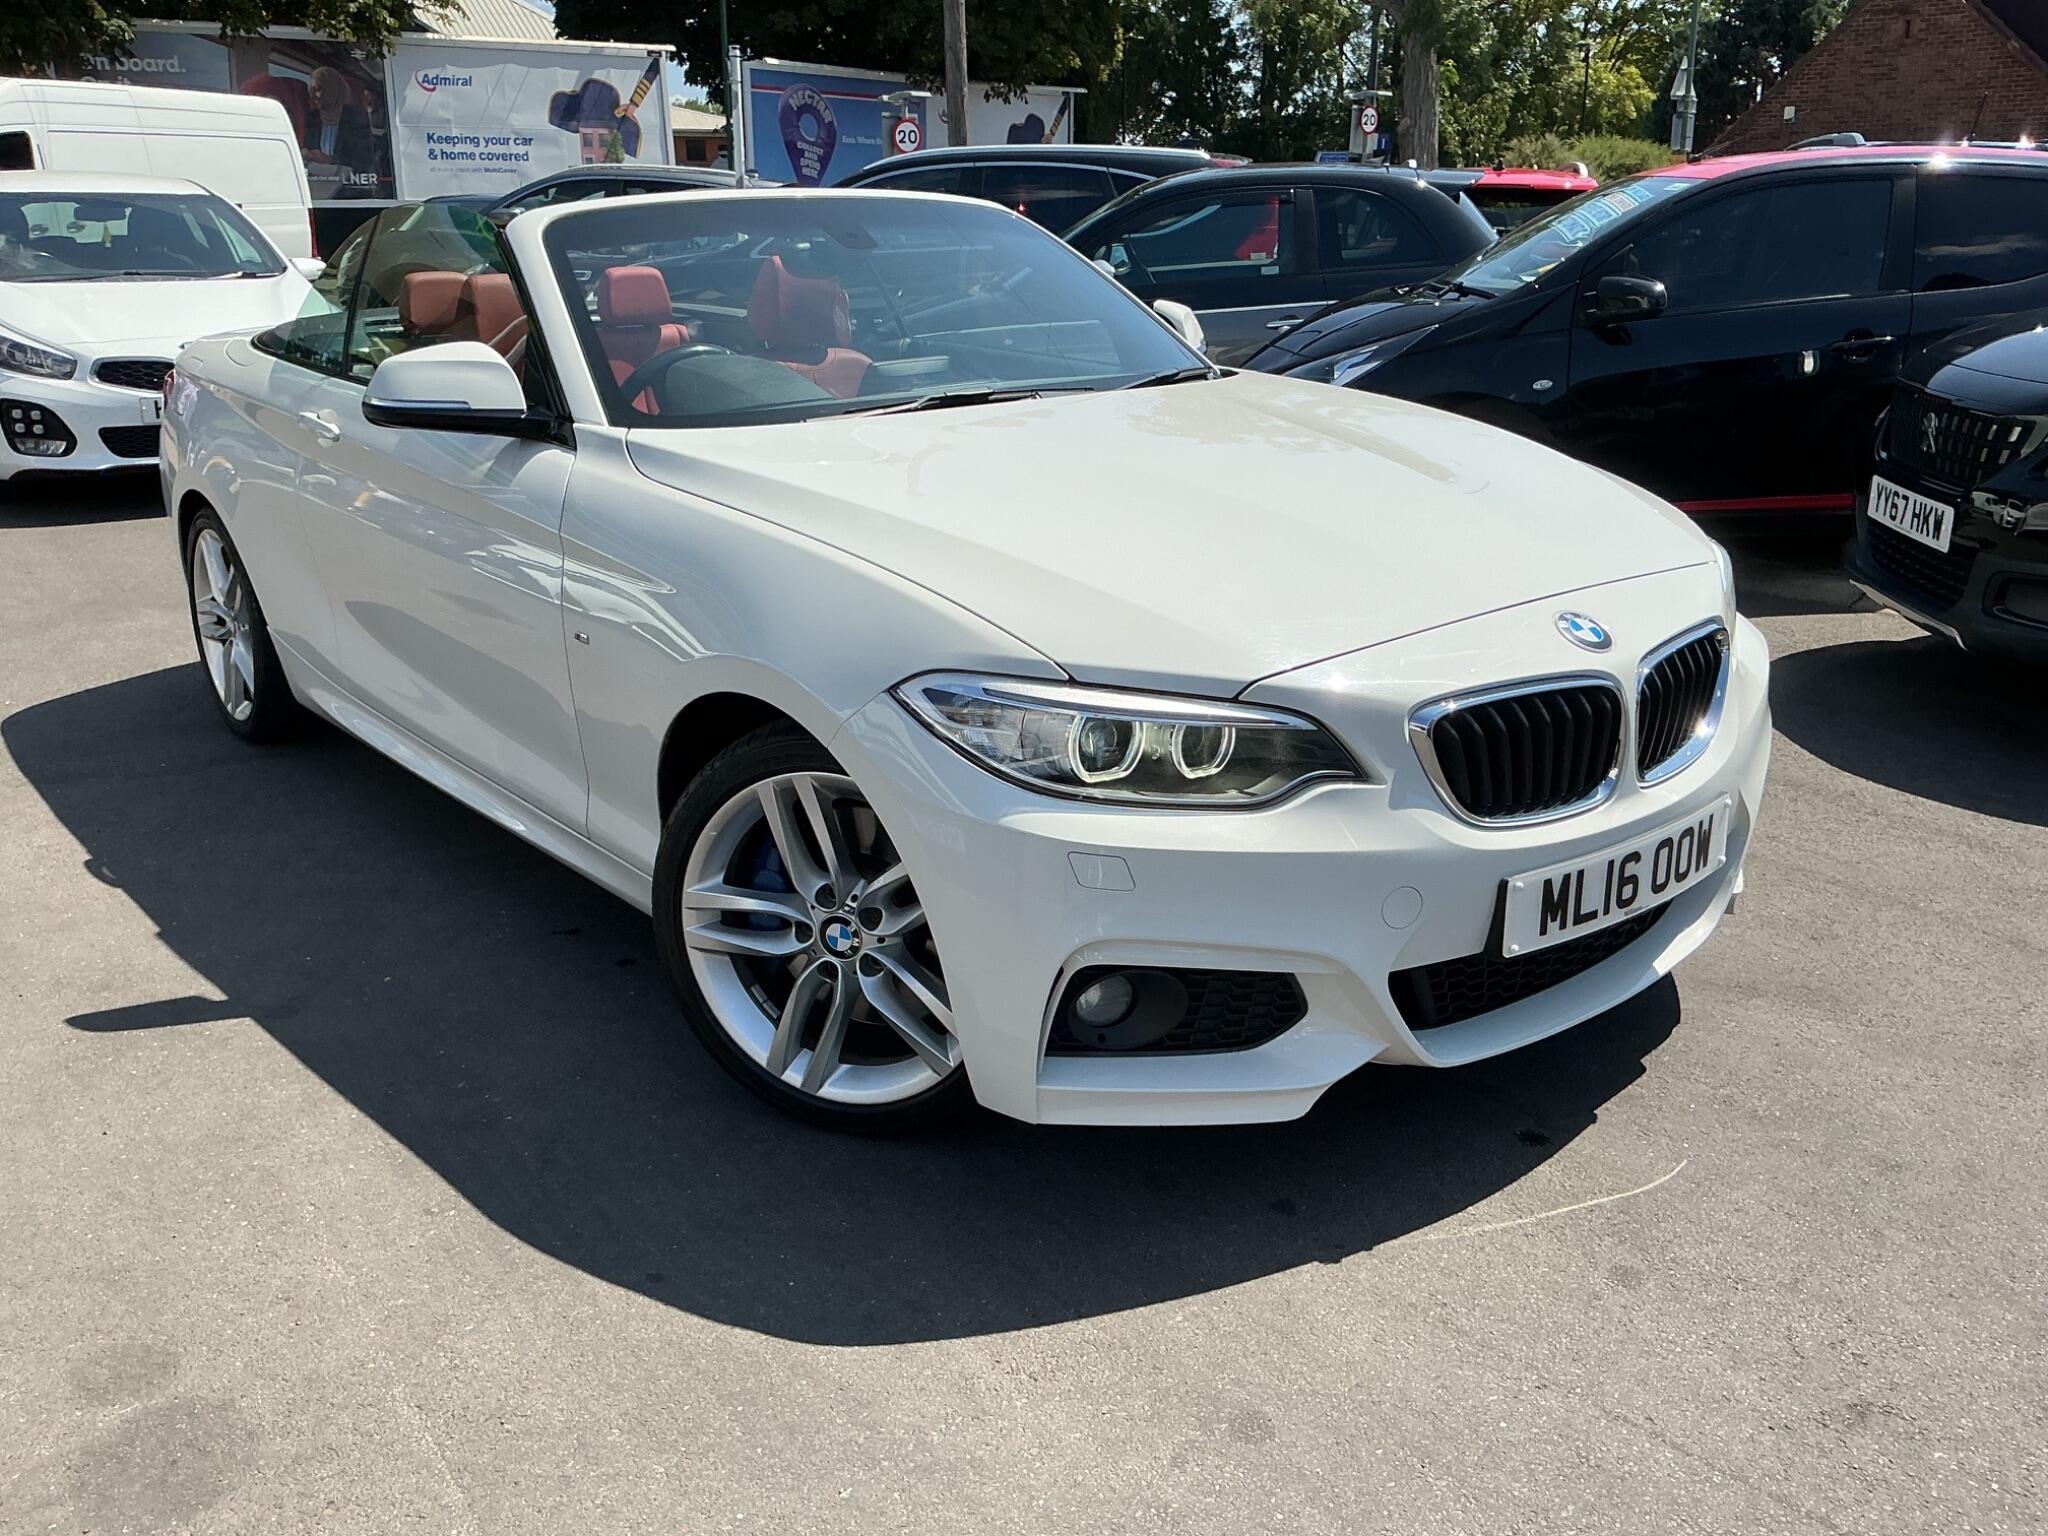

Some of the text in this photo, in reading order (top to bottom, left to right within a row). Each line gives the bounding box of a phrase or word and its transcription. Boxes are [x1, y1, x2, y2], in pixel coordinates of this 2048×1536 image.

[421, 73, 473, 87] Admiral
[788, 89, 832, 124] NECTAR
[1363, 113, 1377, 126] 20
[426, 132, 534, 148] Keeping your car
[898, 129, 918, 144] 20
[427, 148, 530, 162] & home covered
[797, 141, 824, 156] COLLECT
[341, 172, 379, 186] LNER
[1875, 482, 1945, 541] YY67 HKW
[1538, 813, 1715, 937] ML16 OOW
